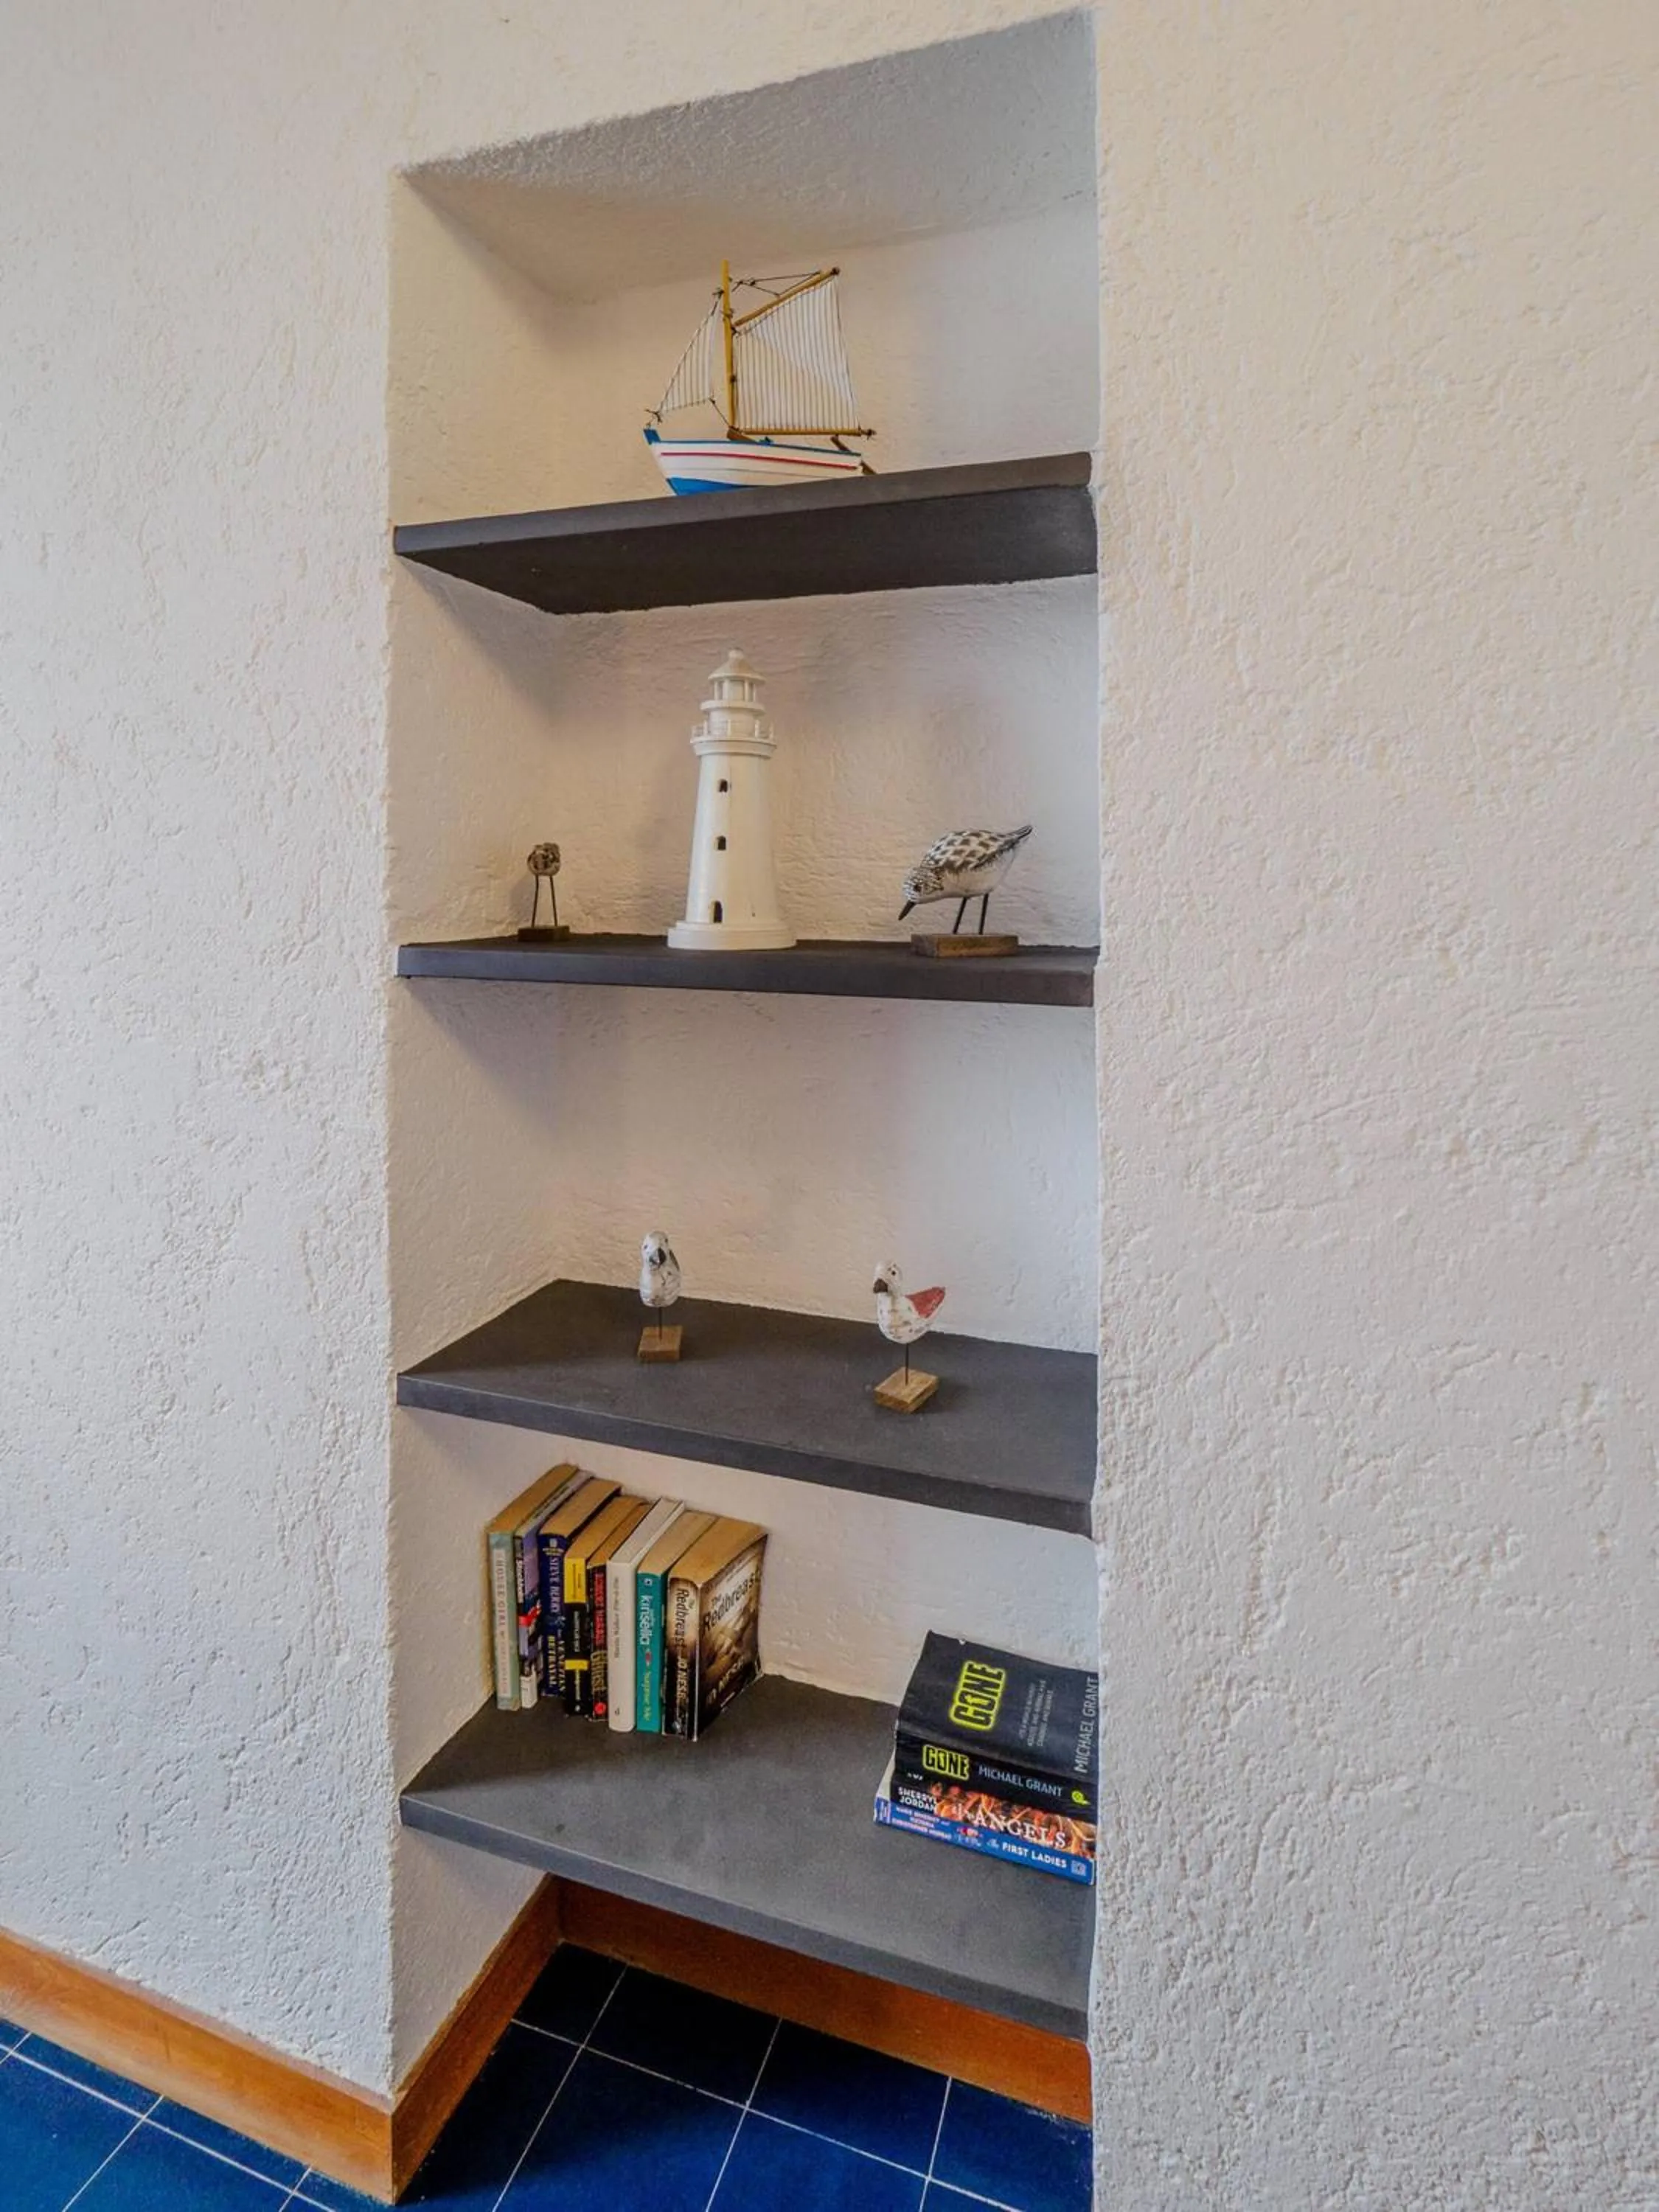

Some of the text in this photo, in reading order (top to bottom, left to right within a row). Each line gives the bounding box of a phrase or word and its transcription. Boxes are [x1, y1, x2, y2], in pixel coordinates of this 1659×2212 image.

[549, 1556, 559, 1584] STEVE
[549, 1585, 560, 1613] BERRY
[639, 1595, 653, 1645] kinsella
[675, 1587, 689, 1649] Redbreast
[676, 1669, 689, 1703] NESB
[950, 1662, 1006, 1729] GONE
[1074, 1676, 1099, 1773] MICHAEL GRANT
[923, 1745, 1063, 1797] GONE MICHAEL GRANT
[899, 1796, 937, 1812] JORDAN
[973, 1806, 1067, 1848] ANGELS
[1002, 1842, 1029, 1859] FIRST
[1032, 1849, 1067, 1868] LADIES
